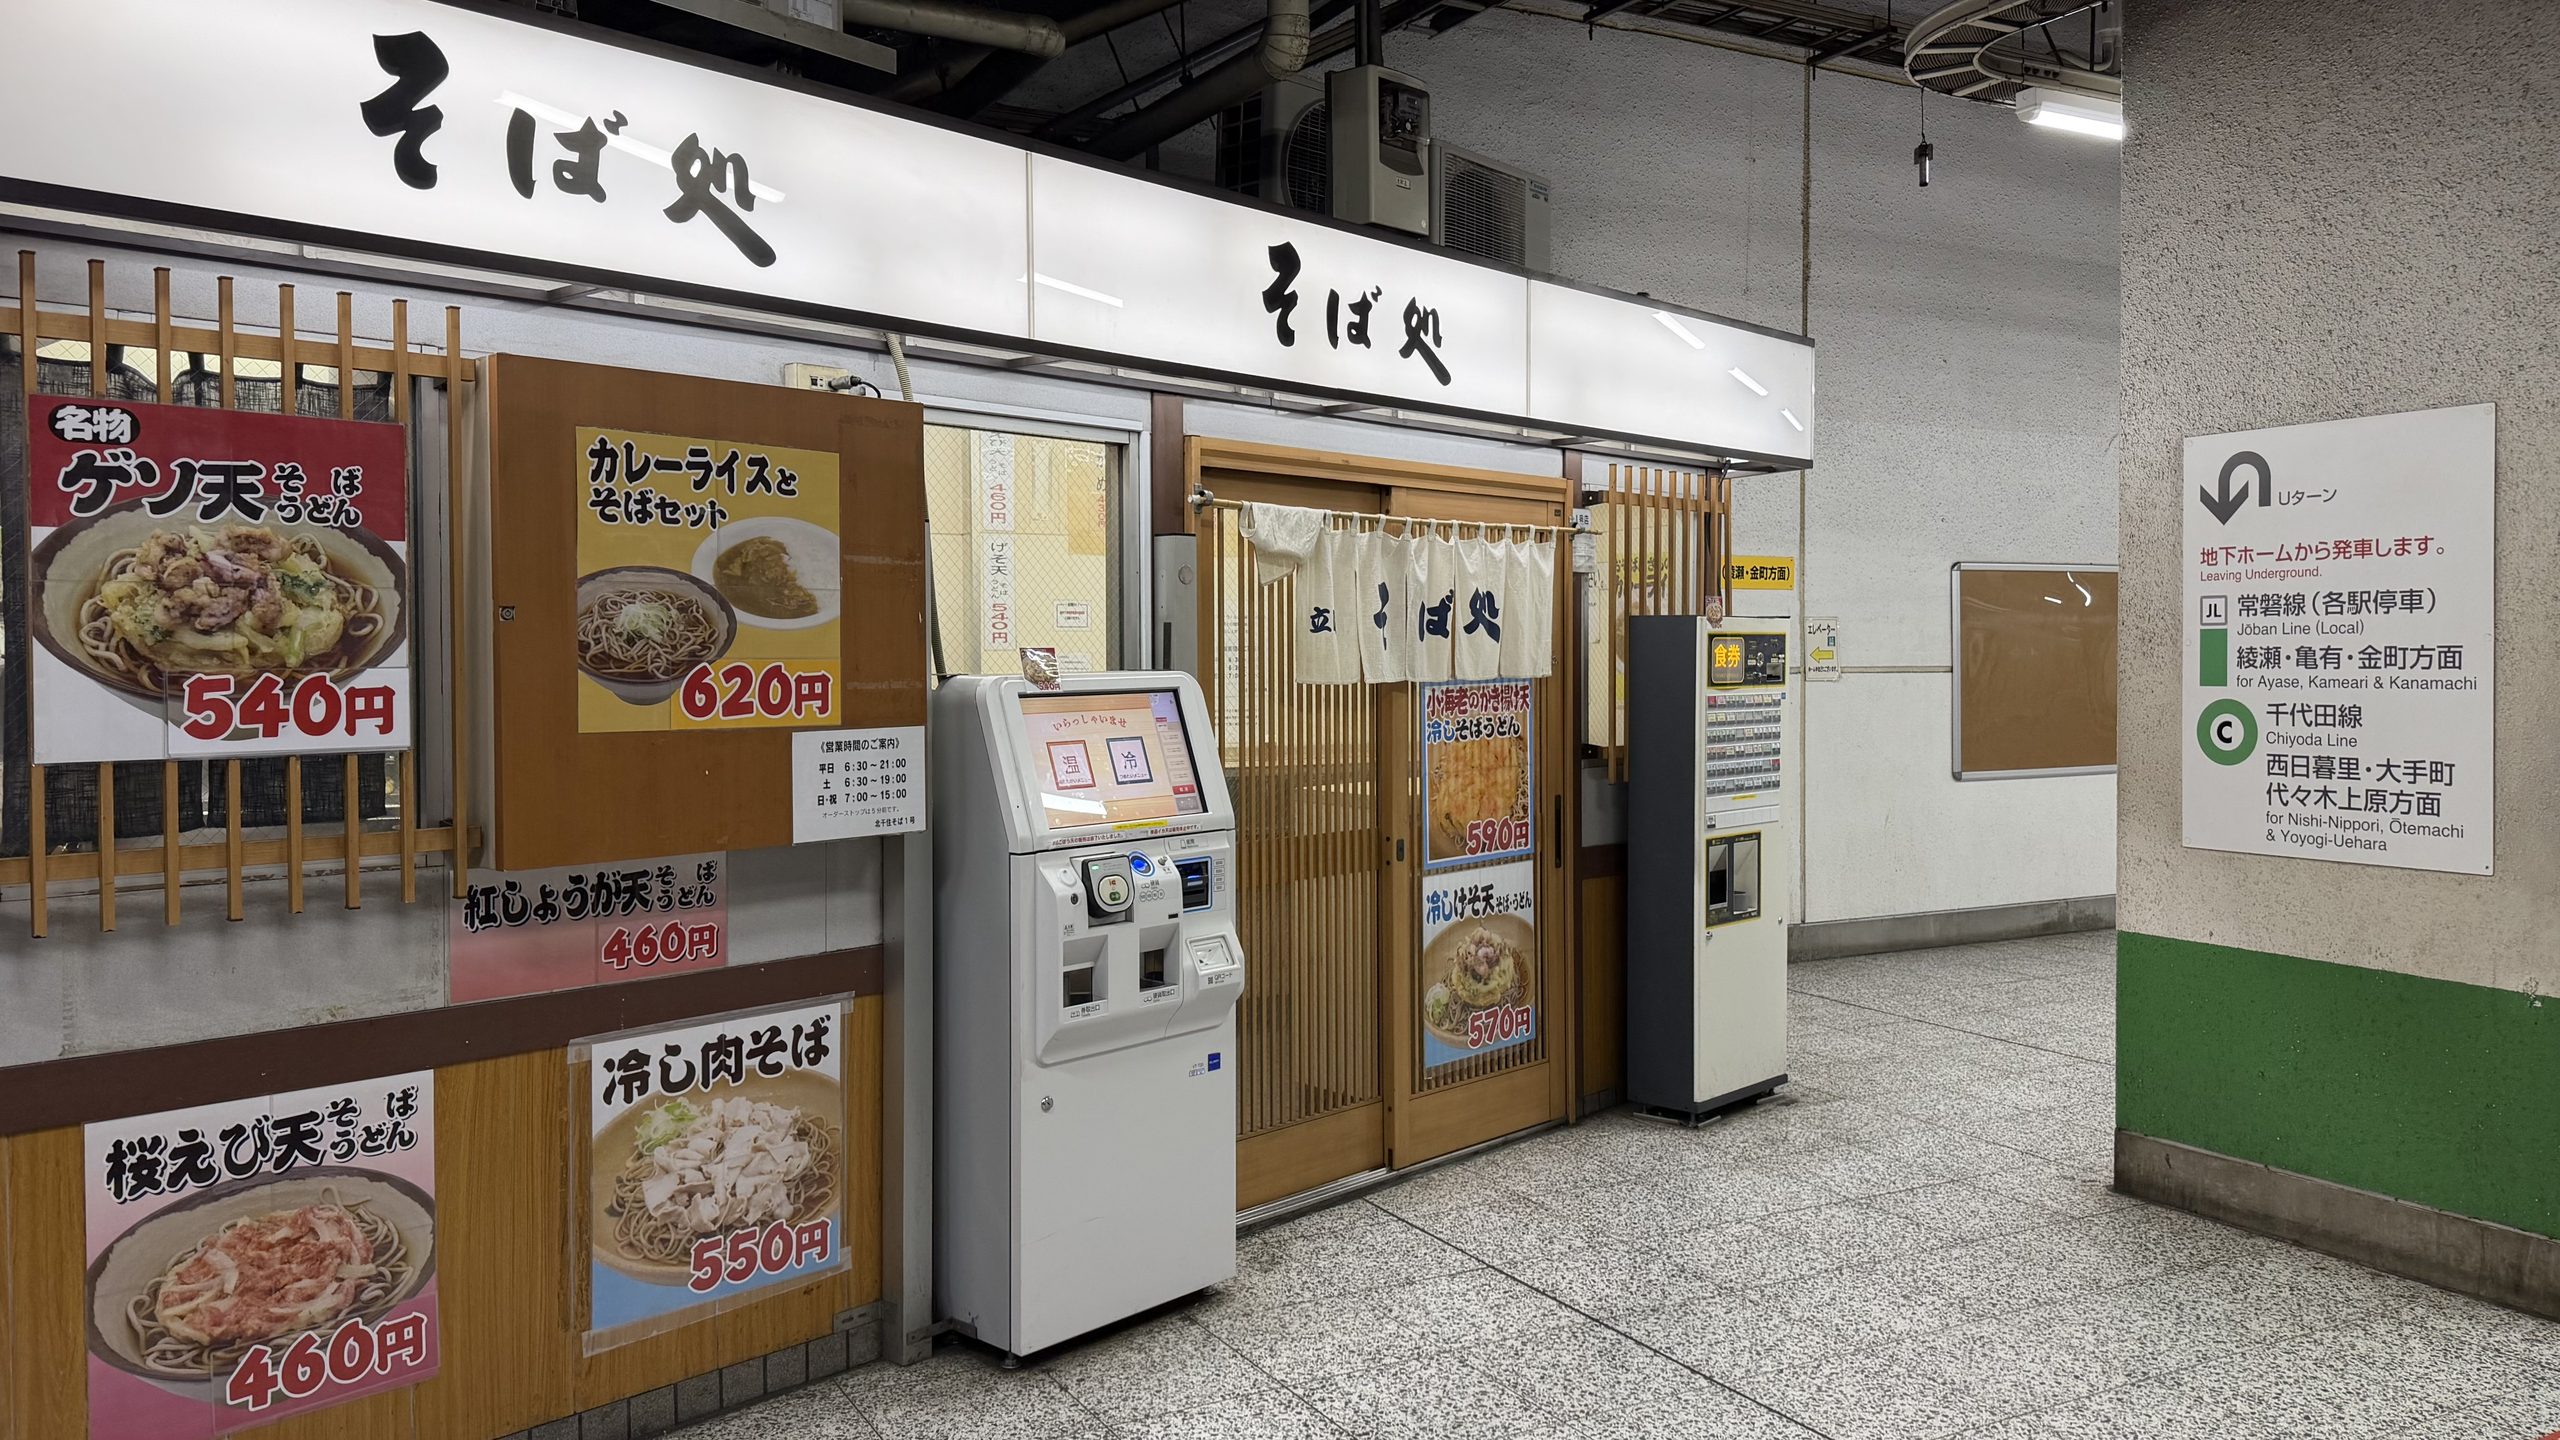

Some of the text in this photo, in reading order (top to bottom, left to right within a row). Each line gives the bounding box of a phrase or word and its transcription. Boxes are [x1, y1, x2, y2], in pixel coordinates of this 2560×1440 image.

[360, 30, 777, 268] そば処
[1262, 240, 1452, 387] そば処
[54, 405, 133, 443] 名物
[587, 436, 799, 497] カレーライスと
[59, 449, 266, 522] ゲソ天
[2278, 489, 2337, 506] Uターン
[276, 495, 362, 527] うどん
[588, 486, 728, 530] そばセット
[990, 483, 1007, 524] 460円
[991, 542, 1008, 576] げそ天
[2200, 536, 2445, 566] 地下ホームから発車します。
[2200, 566, 2322, 583] Leaving Underground.
[2206, 604, 2222, 618] JL
[2237, 587, 2436, 618] 常磐線(各駅停車)
[992, 603, 1008, 643] 540円
[2282, 622, 2311, 635] Line
[2316, 619, 2364, 636] (Local)
[1714, 643, 1741, 668] 食券
[2236, 644, 2463, 671] 綾瀬・亀有・金町方面
[681, 662, 832, 721] 620円
[2236, 675, 2477, 690] for Ayase, Kameari & Kanamachi
[183, 673, 396, 741] 540円
[2266, 702, 2362, 729] 千代田線
[1053, 714, 1127, 732] いらっしゃいませ
[1427, 715, 1521, 743] 冷しそばうどん
[2216, 720, 2233, 744] C
[820, 738, 900, 753] 《営業時間のご案内》
[2266, 732, 2358, 748] Chiyoda Line
[819, 763, 834, 774] 平日
[1063, 755, 1080, 774] 温
[1121, 751, 1137, 769] 冷
[2266, 753, 2455, 786] 西日暮里・大手町
[823, 779, 831, 789] 土
[2266, 782, 2442, 817] 代々木上原方面
[817, 794, 837, 806] 日・祝
[1467, 817, 1530, 856] 590円
[2266, 811, 2464, 839] for Nishi-Nippori, Ōtemachi
[2266, 829, 2387, 851] & Yoyogi-Uehara
[463, 869, 652, 932] 紅しょうが天
[657, 884, 716, 911] うどん
[602, 920, 719, 969] 460円
[1468, 1004, 1531, 1049] 570円
[603, 1014, 832, 1106] 冷し肉そば
[330, 1120, 418, 1161] うどん
[105, 1110, 325, 1203] 桜えび天
[689, 1217, 832, 1293] 550円
[227, 1312, 428, 1412] 460円
